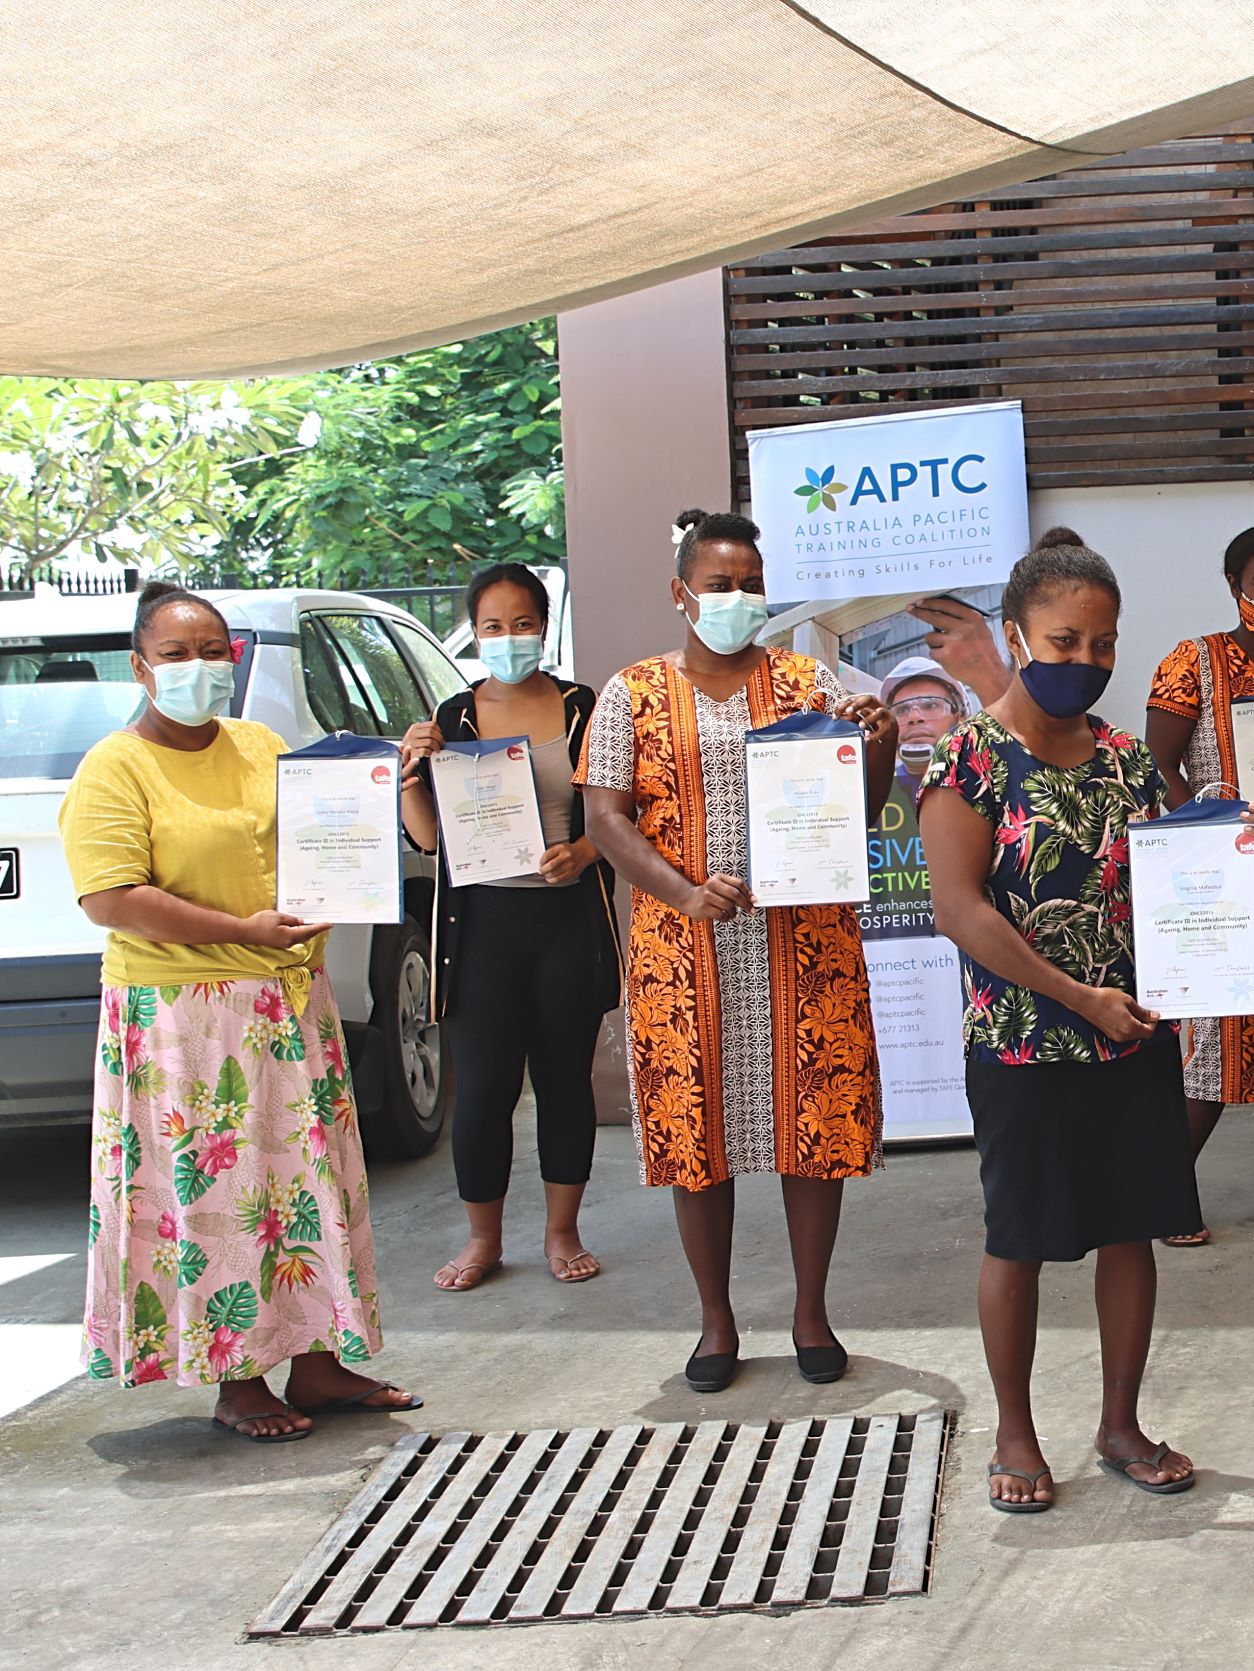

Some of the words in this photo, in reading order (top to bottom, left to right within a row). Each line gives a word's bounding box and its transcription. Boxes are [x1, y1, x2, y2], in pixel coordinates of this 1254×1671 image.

[849, 454, 987, 506] APTC
[795, 517, 903, 537] AUSTRALIA
[913, 507, 990, 526] PACIFIC
[795, 537, 881, 553] TRAINING
[892, 526, 990, 546] COALITION
[796, 568, 865, 581] Creating
[875, 561, 919, 574] Skills
[930, 559, 952, 569] For
[963, 554, 992, 565] Life
[1145, 839, 1168, 847] APTC
[876, 898, 933, 912] enhances
[859, 913, 934, 929] OSPERITY
[921, 954, 953, 968] with
[875, 977, 924, 988] @aptcpacific
[876, 993, 924, 1003] @aptcpacific
[877, 1008, 926, 1019] @aptcpacific
[899, 1024, 920, 1032] 21313
[878, 1039, 944, 1049] www.aptc.edu.au
